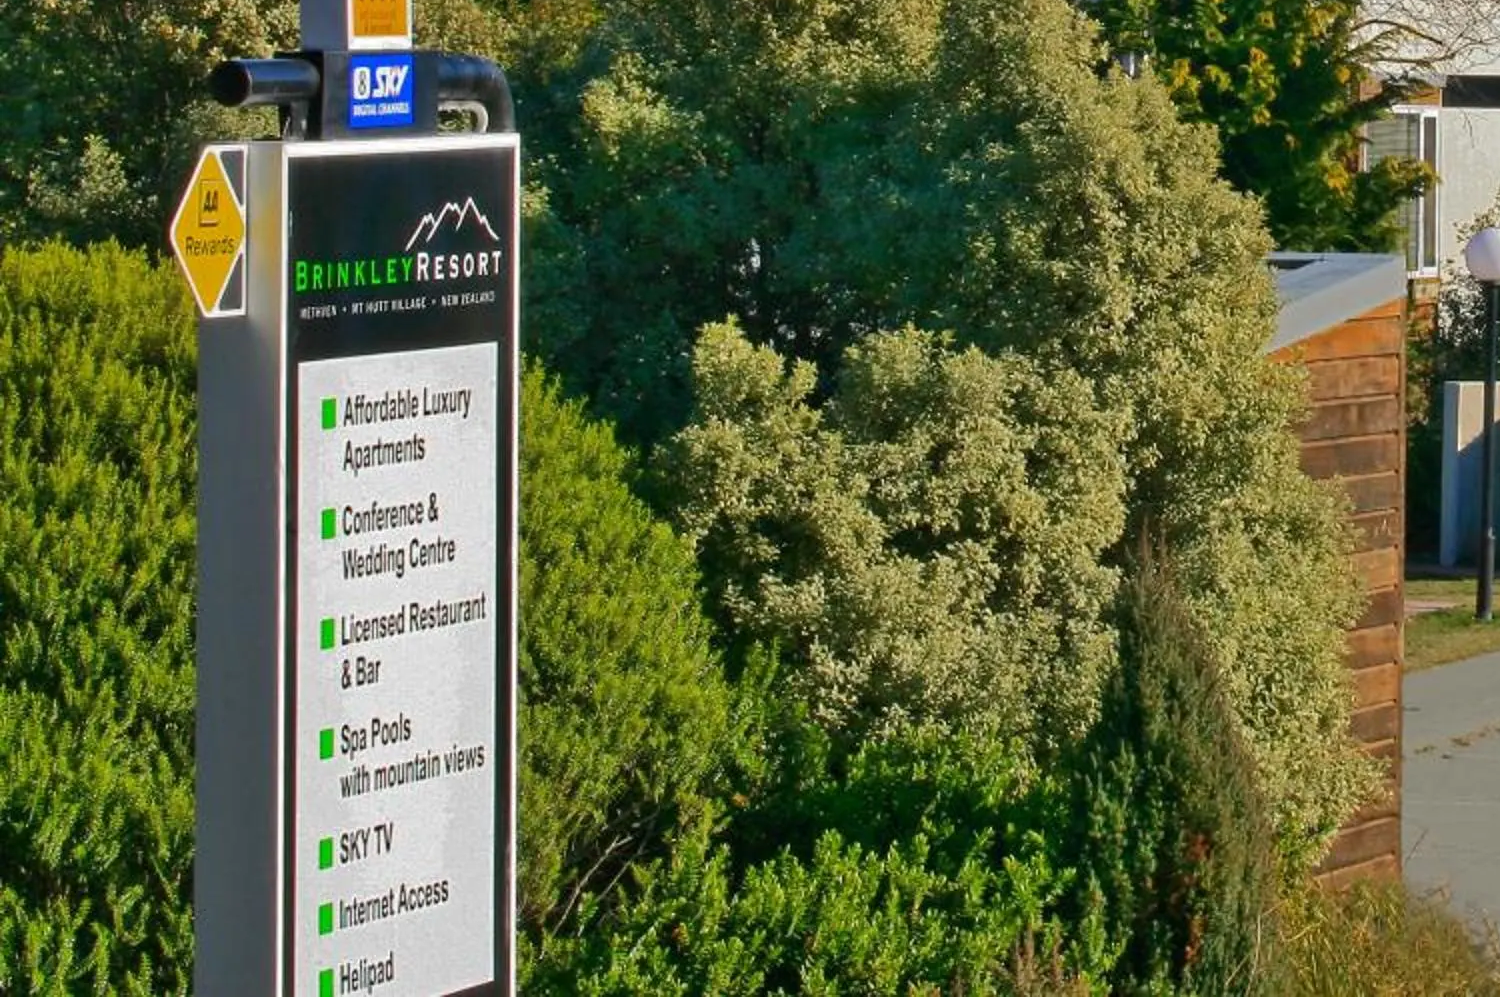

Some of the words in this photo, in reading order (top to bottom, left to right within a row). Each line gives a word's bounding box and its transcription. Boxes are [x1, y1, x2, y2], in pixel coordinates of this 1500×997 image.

[371, 65, 409, 98] SKY
[186, 236, 234, 256] Rewards
[391, 296, 426, 311] VILLAGE
[441, 293, 458, 306] NEW
[461, 290, 495, 305] ZEALAND
[343, 389, 419, 427] Affordable
[423, 387, 472, 419] Luxury
[343, 433, 426, 477] Apartments
[342, 499, 424, 536] Conference
[428, 492, 439, 523] &
[342, 540, 405, 580] Wedding
[409, 535, 455, 568] Centre
[341, 605, 405, 646] Licensed
[409, 592, 487, 633] Restaurant
[341, 659, 351, 690] &
[356, 655, 381, 687] Bar
[340, 723, 367, 760] Spa
[371, 712, 412, 746] Pools
[340, 763, 370, 798] with
[374, 749, 440, 788] mountain
[444, 743, 485, 774] views
[339, 827, 371, 865] SKY
[374, 822, 394, 853] TV
[339, 888, 394, 930] Internet
[397, 879, 449, 913] Access
[340, 950, 394, 995] Helipad
